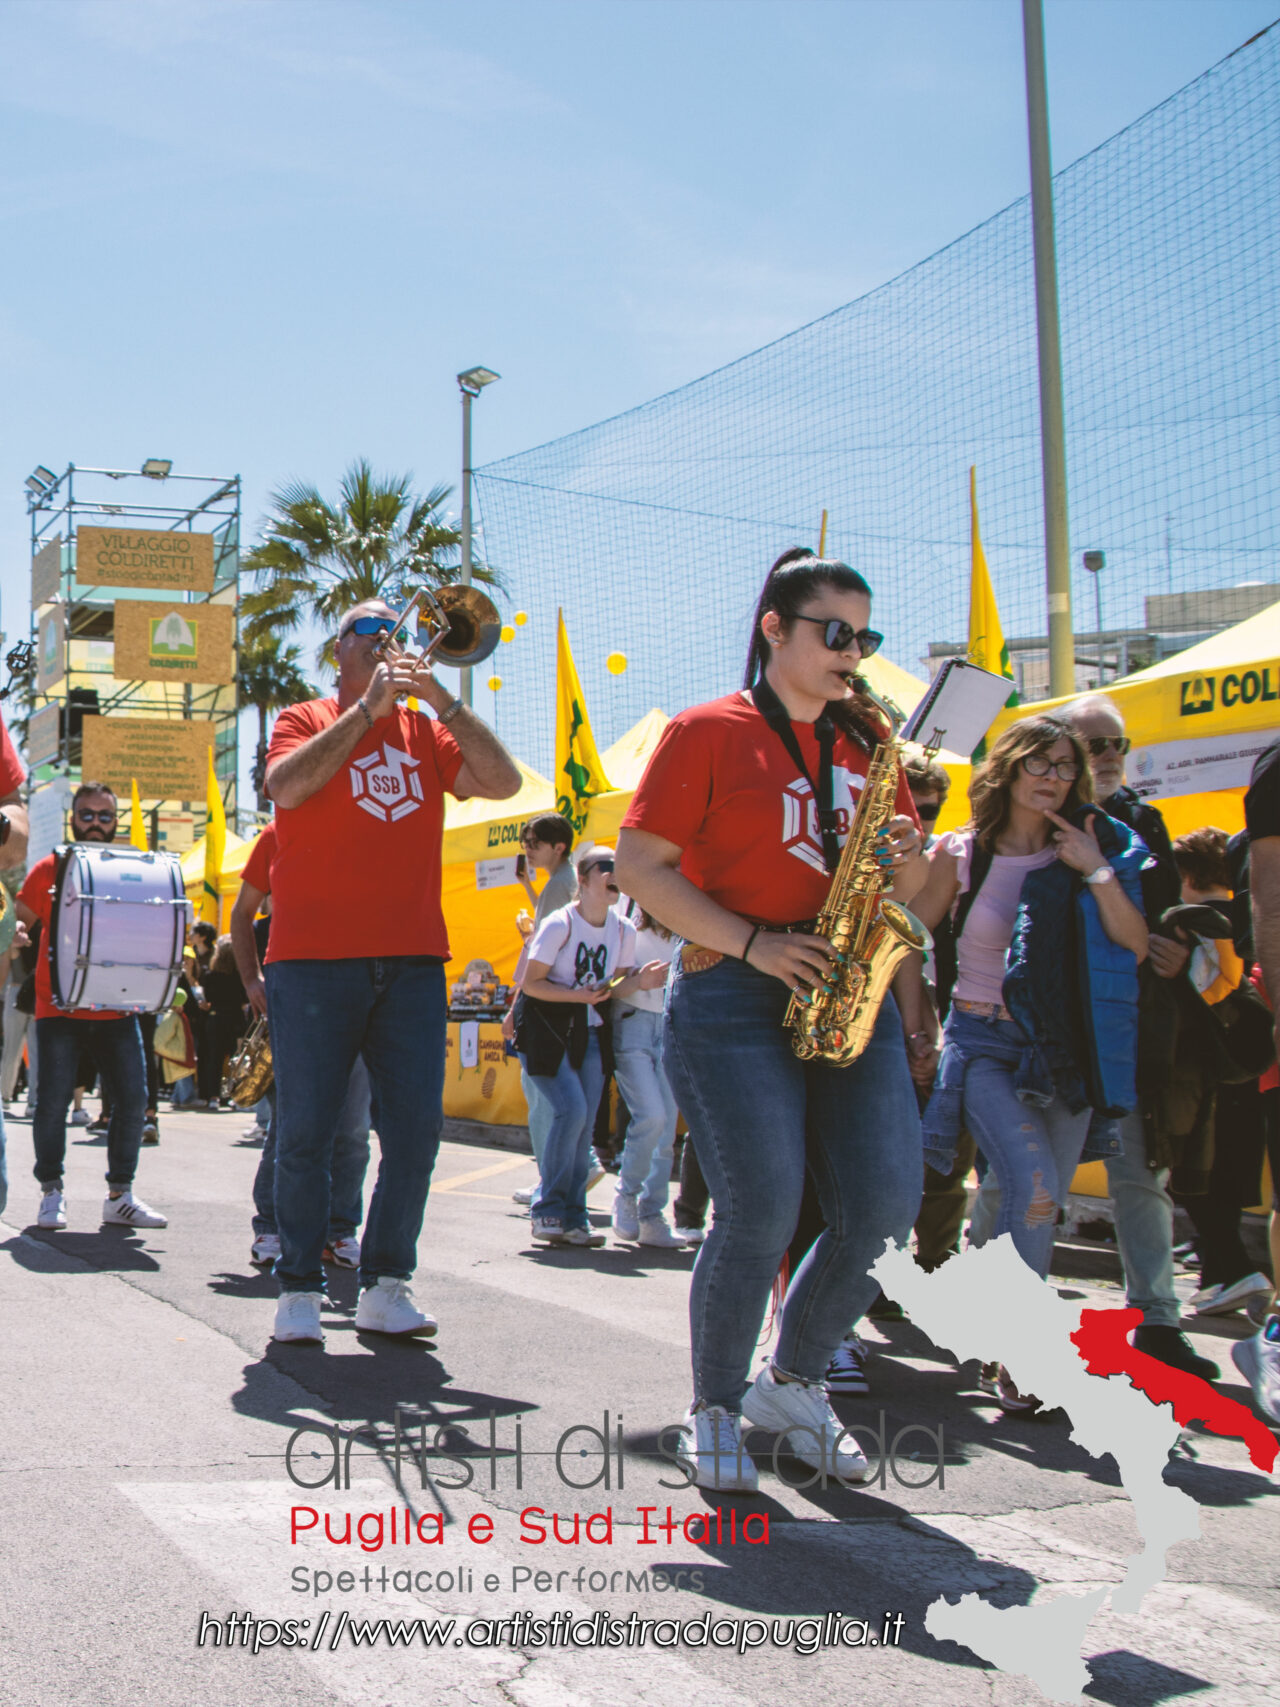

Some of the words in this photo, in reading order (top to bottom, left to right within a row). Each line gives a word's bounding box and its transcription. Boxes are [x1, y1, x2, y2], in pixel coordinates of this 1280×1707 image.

[100, 534, 191, 554] VILLAGGIO
[96, 551, 195, 571] COLDIRETTI
[148, 658, 199, 670] COLDIRETTI
[1221, 666, 1280, 708] COL
[1239, 745, 1268, 758] GIUSE
[372, 774, 401, 795] SSB
